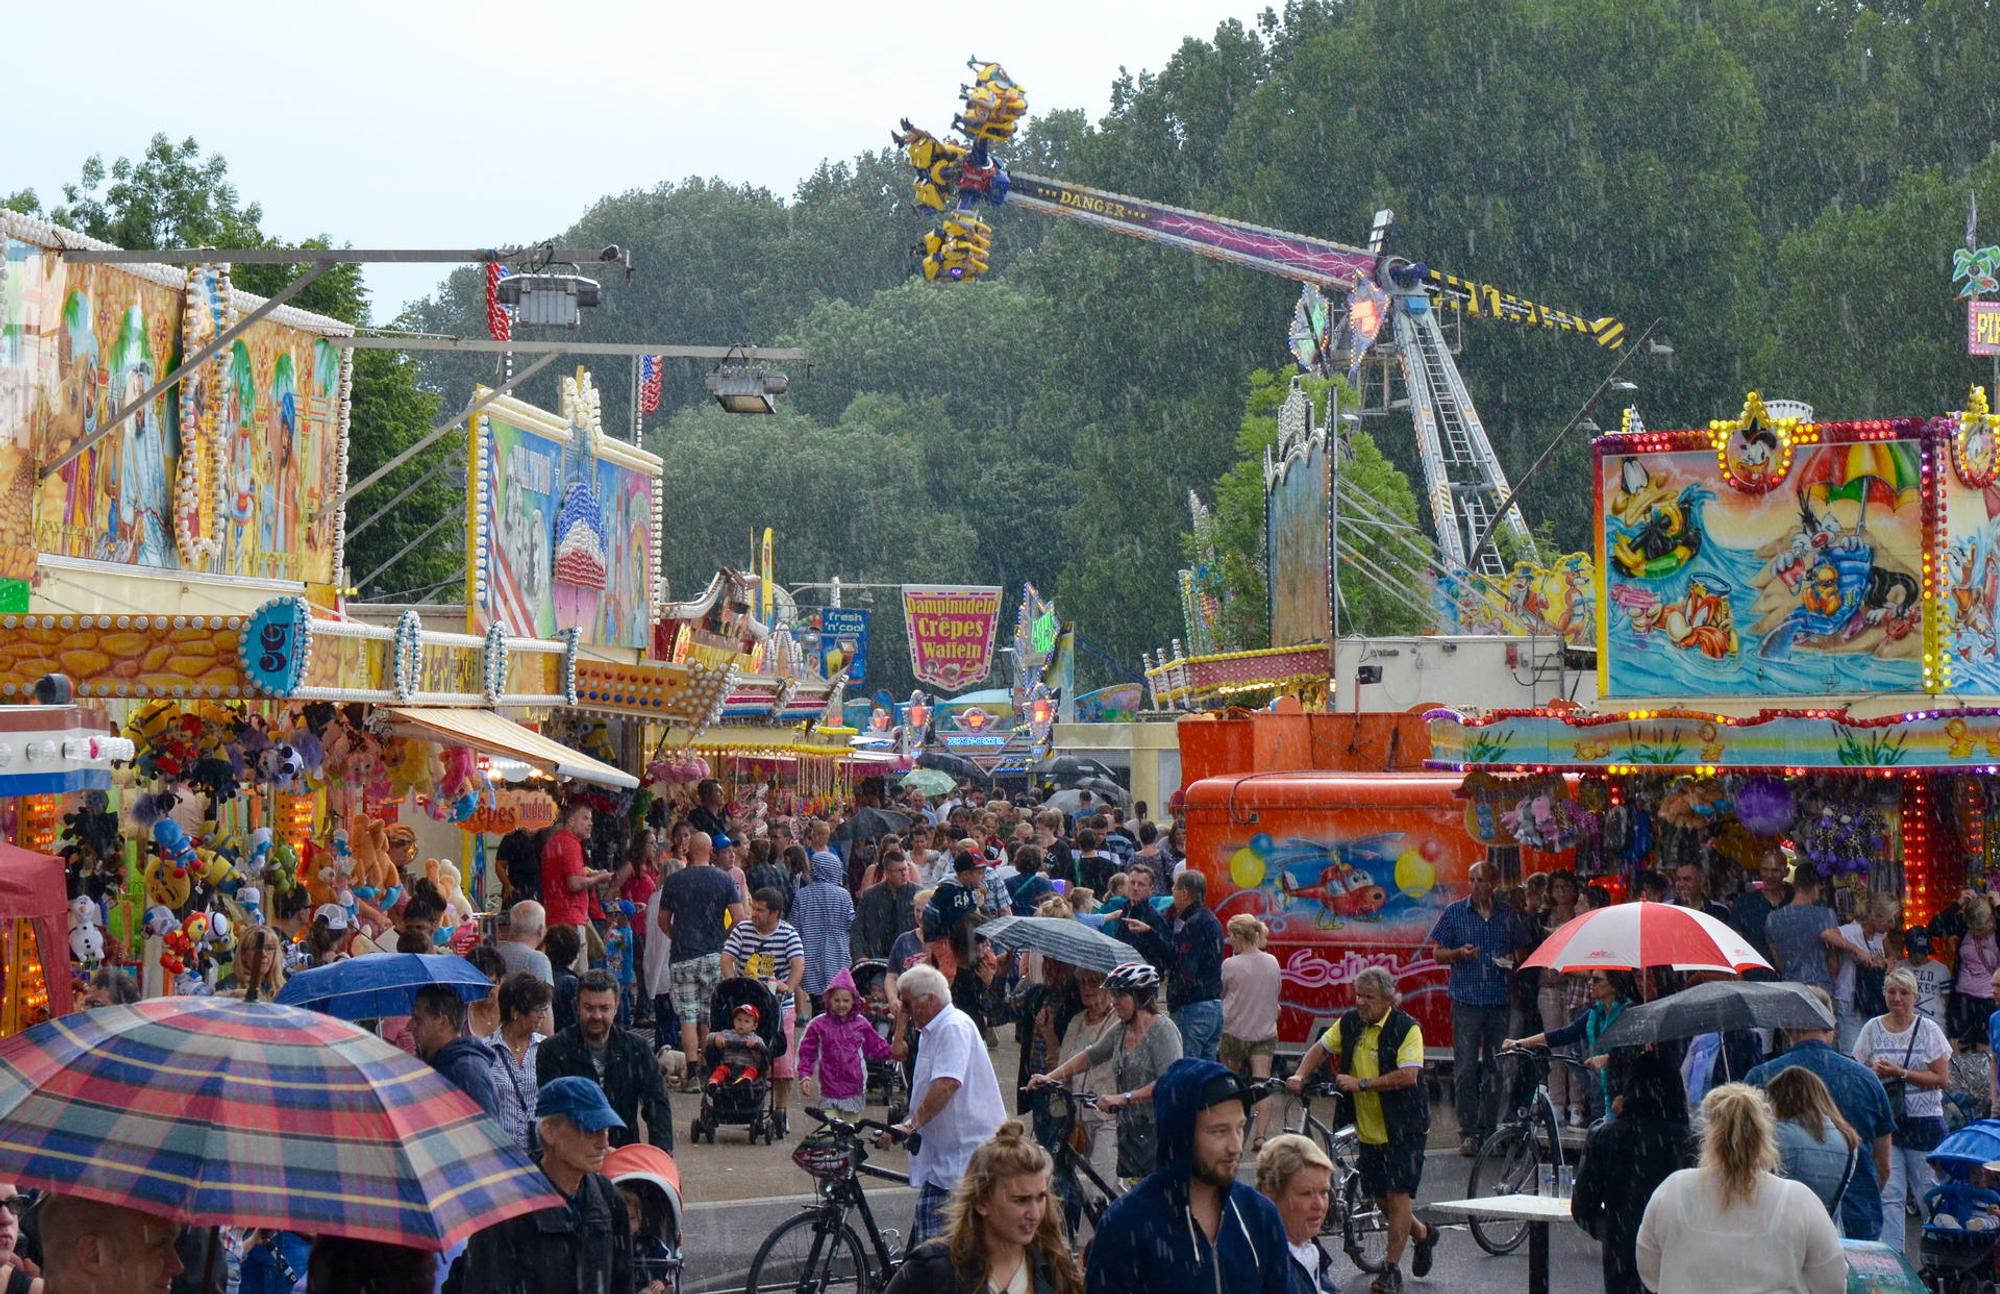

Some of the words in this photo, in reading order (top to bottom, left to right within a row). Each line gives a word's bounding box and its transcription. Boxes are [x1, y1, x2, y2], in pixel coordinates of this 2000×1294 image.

[1059, 190, 1125, 218] DANGER
[906, 597, 996, 616] Dampfnudeln
[829, 612, 863, 622] fresh
[918, 617, 984, 639] Crêpes
[921, 641, 981, 658] Waffeln
